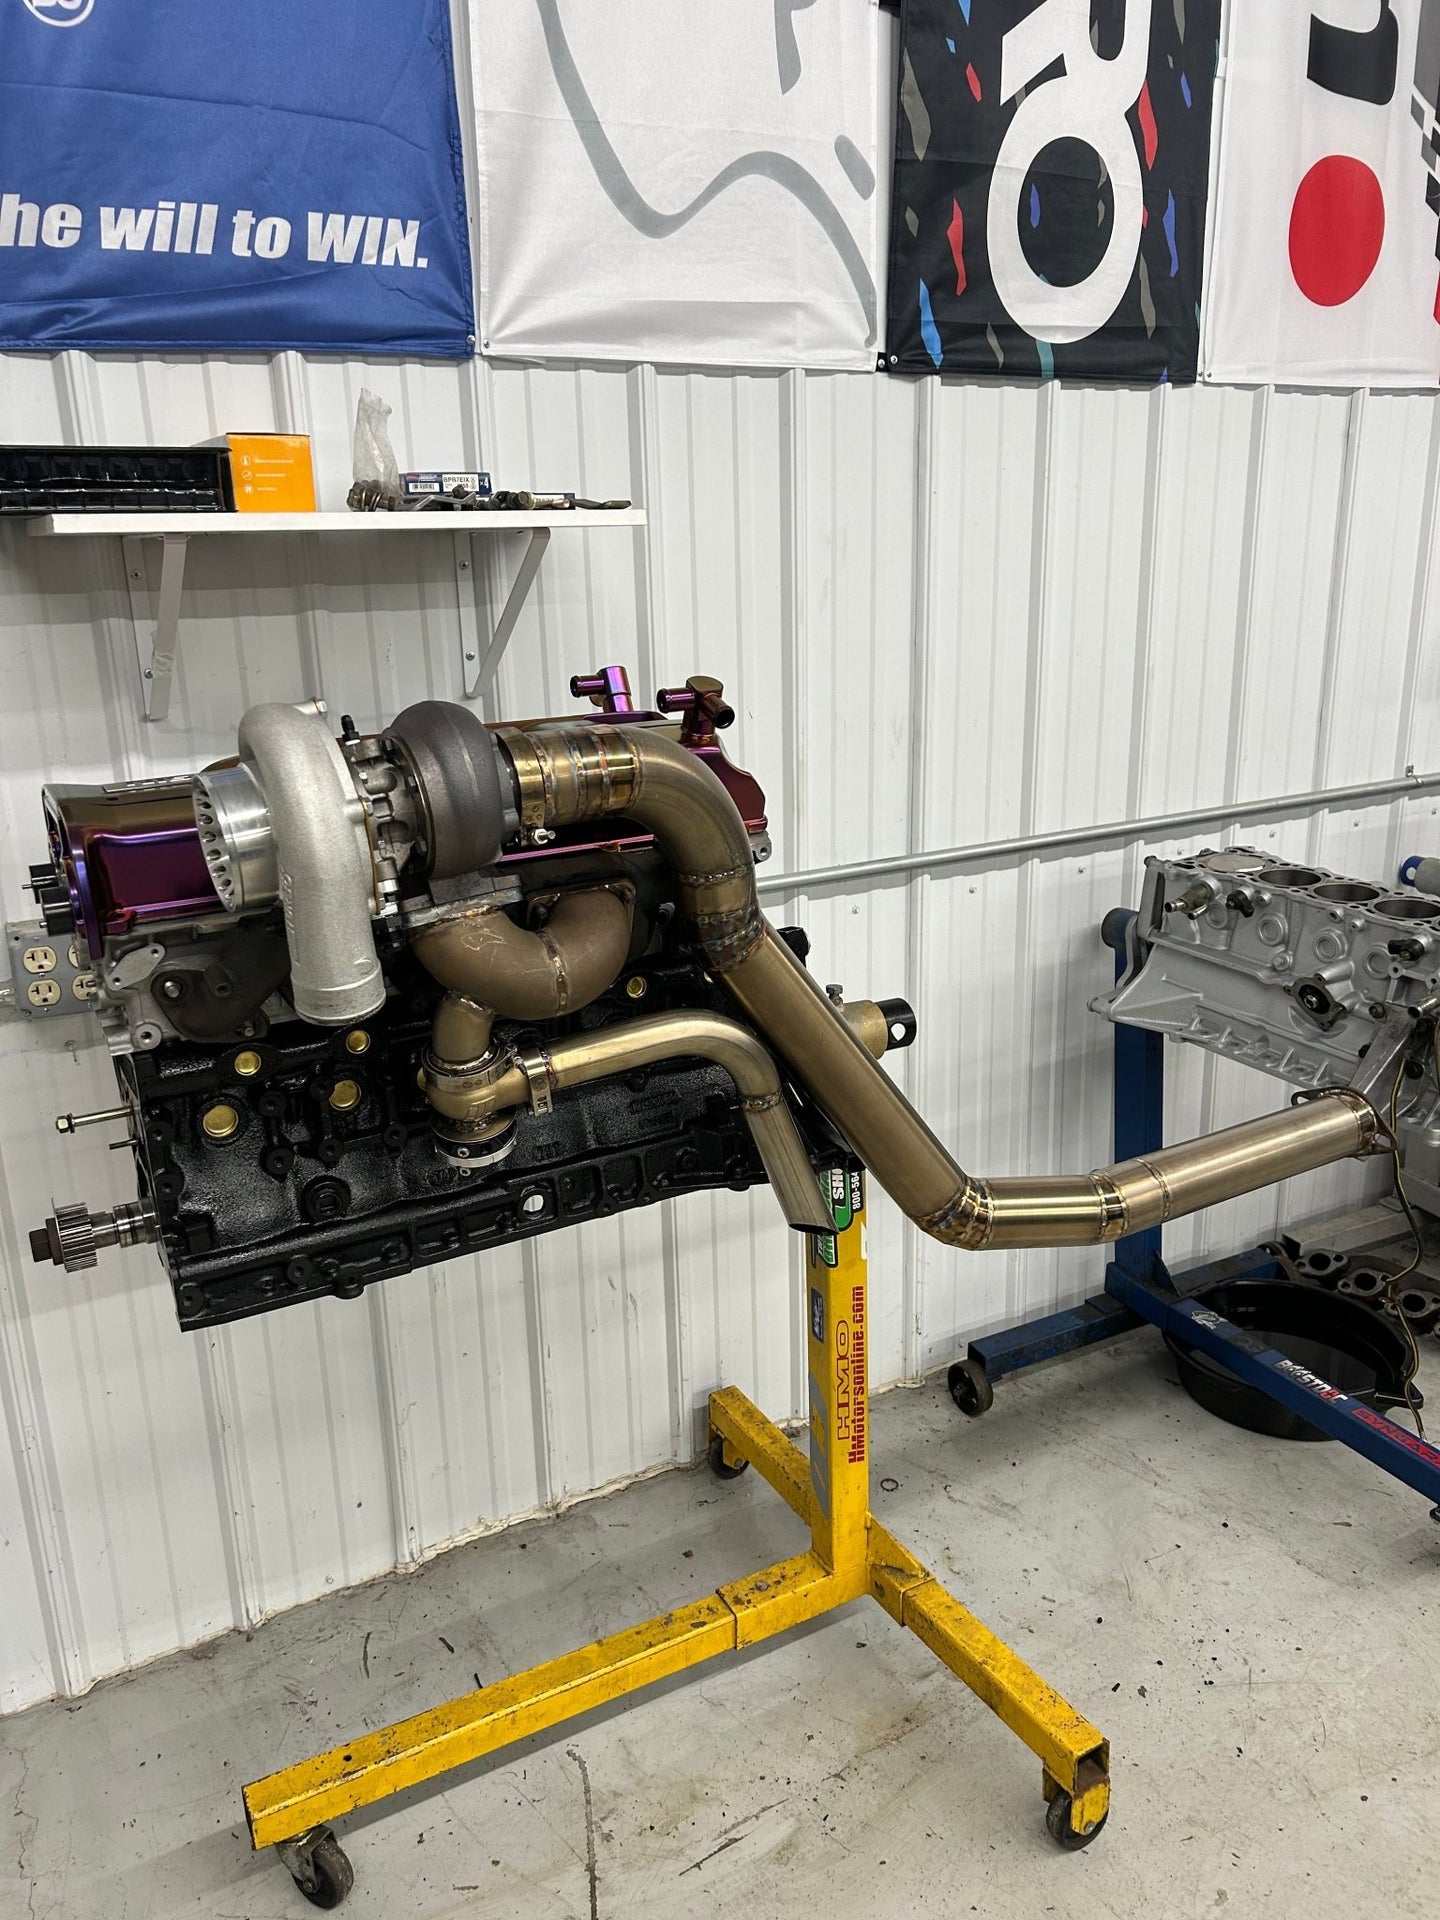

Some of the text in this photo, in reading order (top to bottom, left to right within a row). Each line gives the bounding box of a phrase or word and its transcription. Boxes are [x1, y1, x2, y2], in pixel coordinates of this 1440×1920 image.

[99, 201, 219, 255] will
[232, 210, 292, 260] to
[307, 211, 430, 269] WIN.
[836, 1320, 850, 1440] HMO
